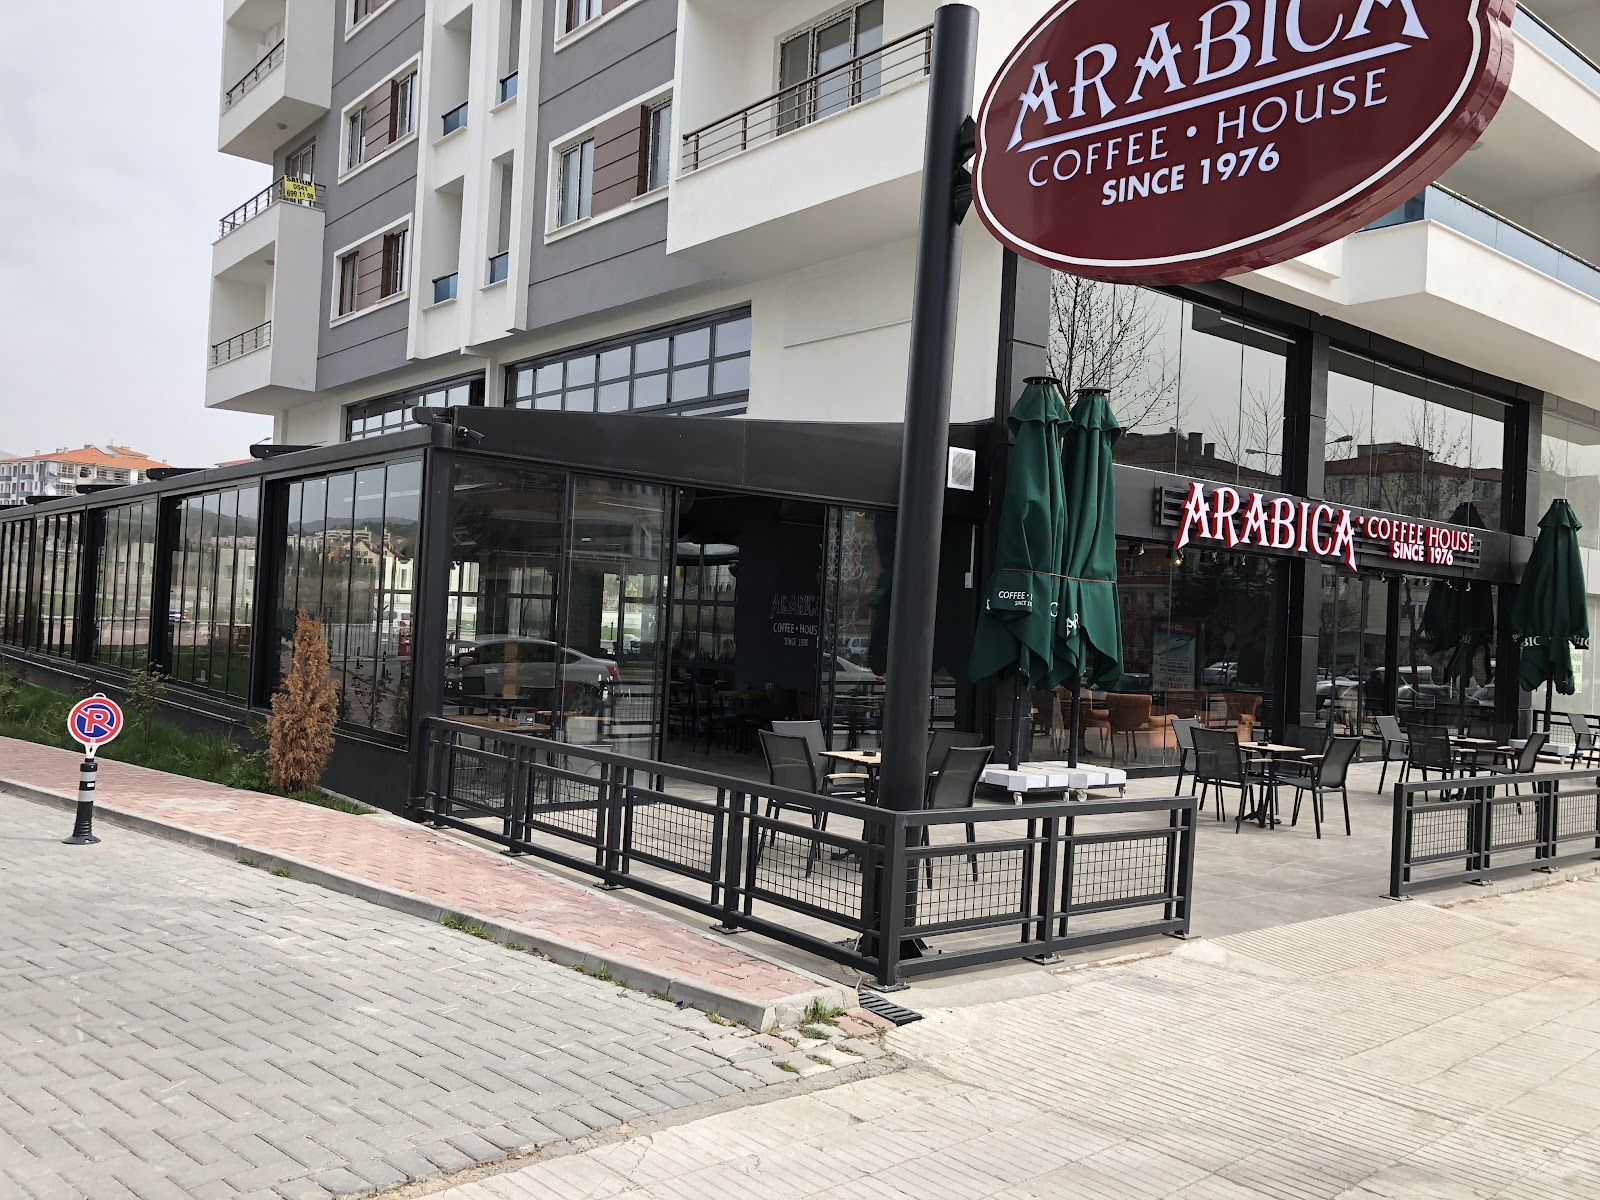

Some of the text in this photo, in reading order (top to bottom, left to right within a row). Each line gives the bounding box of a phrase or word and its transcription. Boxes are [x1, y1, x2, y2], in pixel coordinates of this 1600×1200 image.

[1028, 68, 1388, 187] COFFEE HOUSE
[1101, 142, 1280, 205] SINCE 1976
[1174, 482, 1358, 572] ARABICA
[1364, 516, 1475, 552] COFFEE HOUSE
[1390, 541, 1454, 565] SINCE 1976
[998, 590, 1026, 600] COFFEE
[773, 623, 817, 635] COFFEE HOUS
